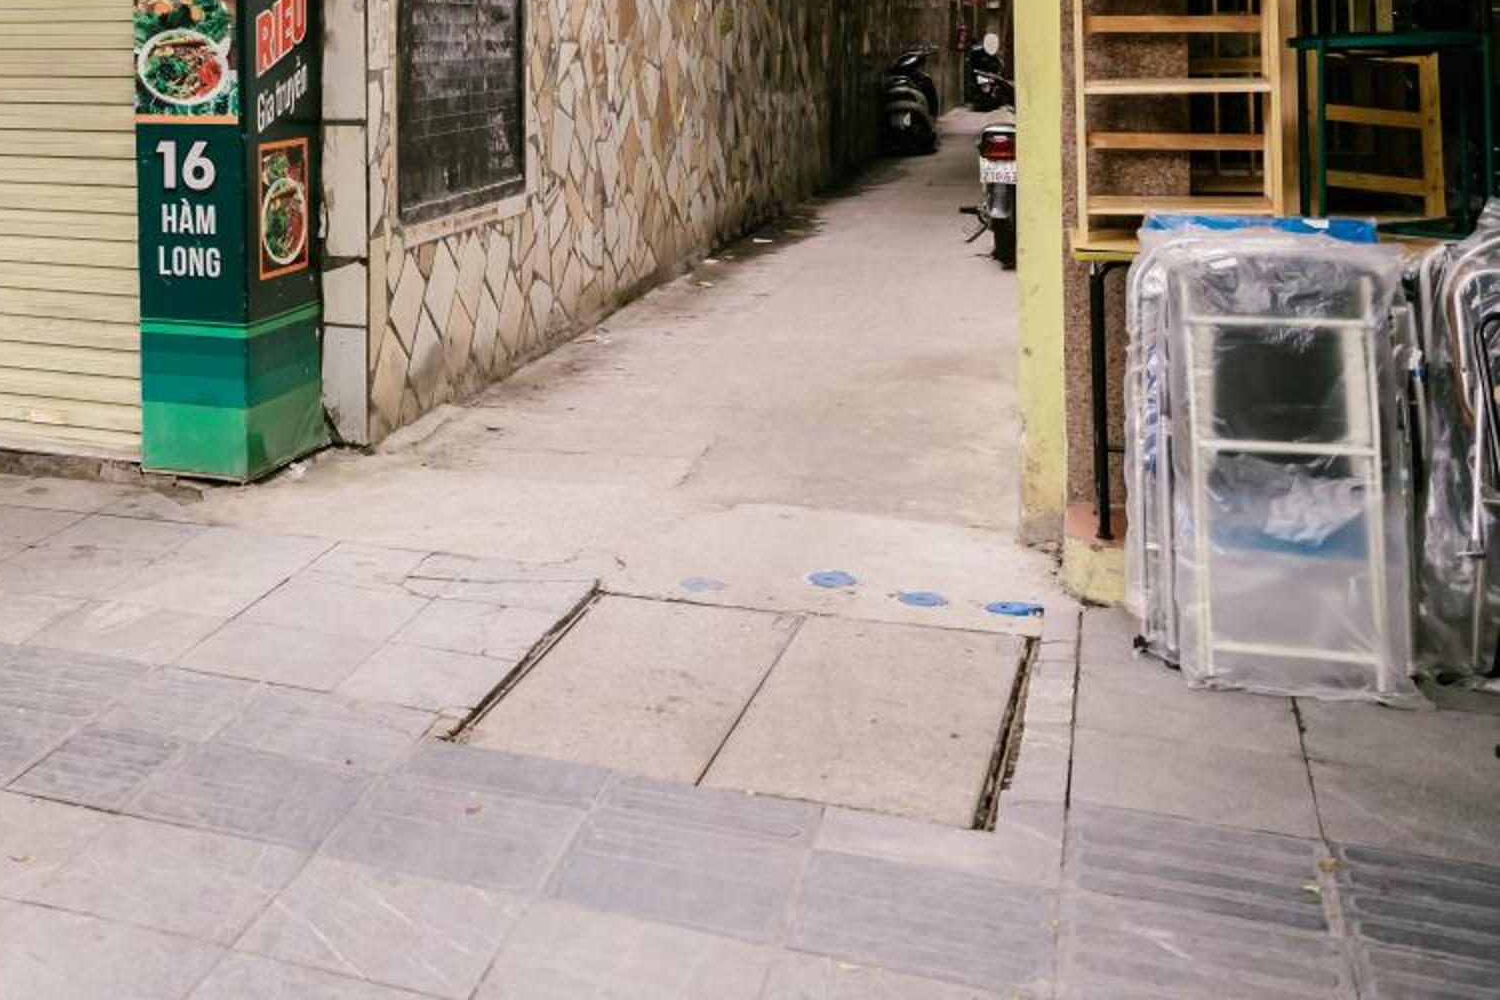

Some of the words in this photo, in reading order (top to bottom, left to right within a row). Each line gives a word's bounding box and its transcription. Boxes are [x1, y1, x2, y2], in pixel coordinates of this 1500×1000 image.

[256, 87, 275, 134] Gia
[155, 140, 216, 191] 16
[161, 197, 217, 237] HÀM
[157, 245, 222, 279] LONG
